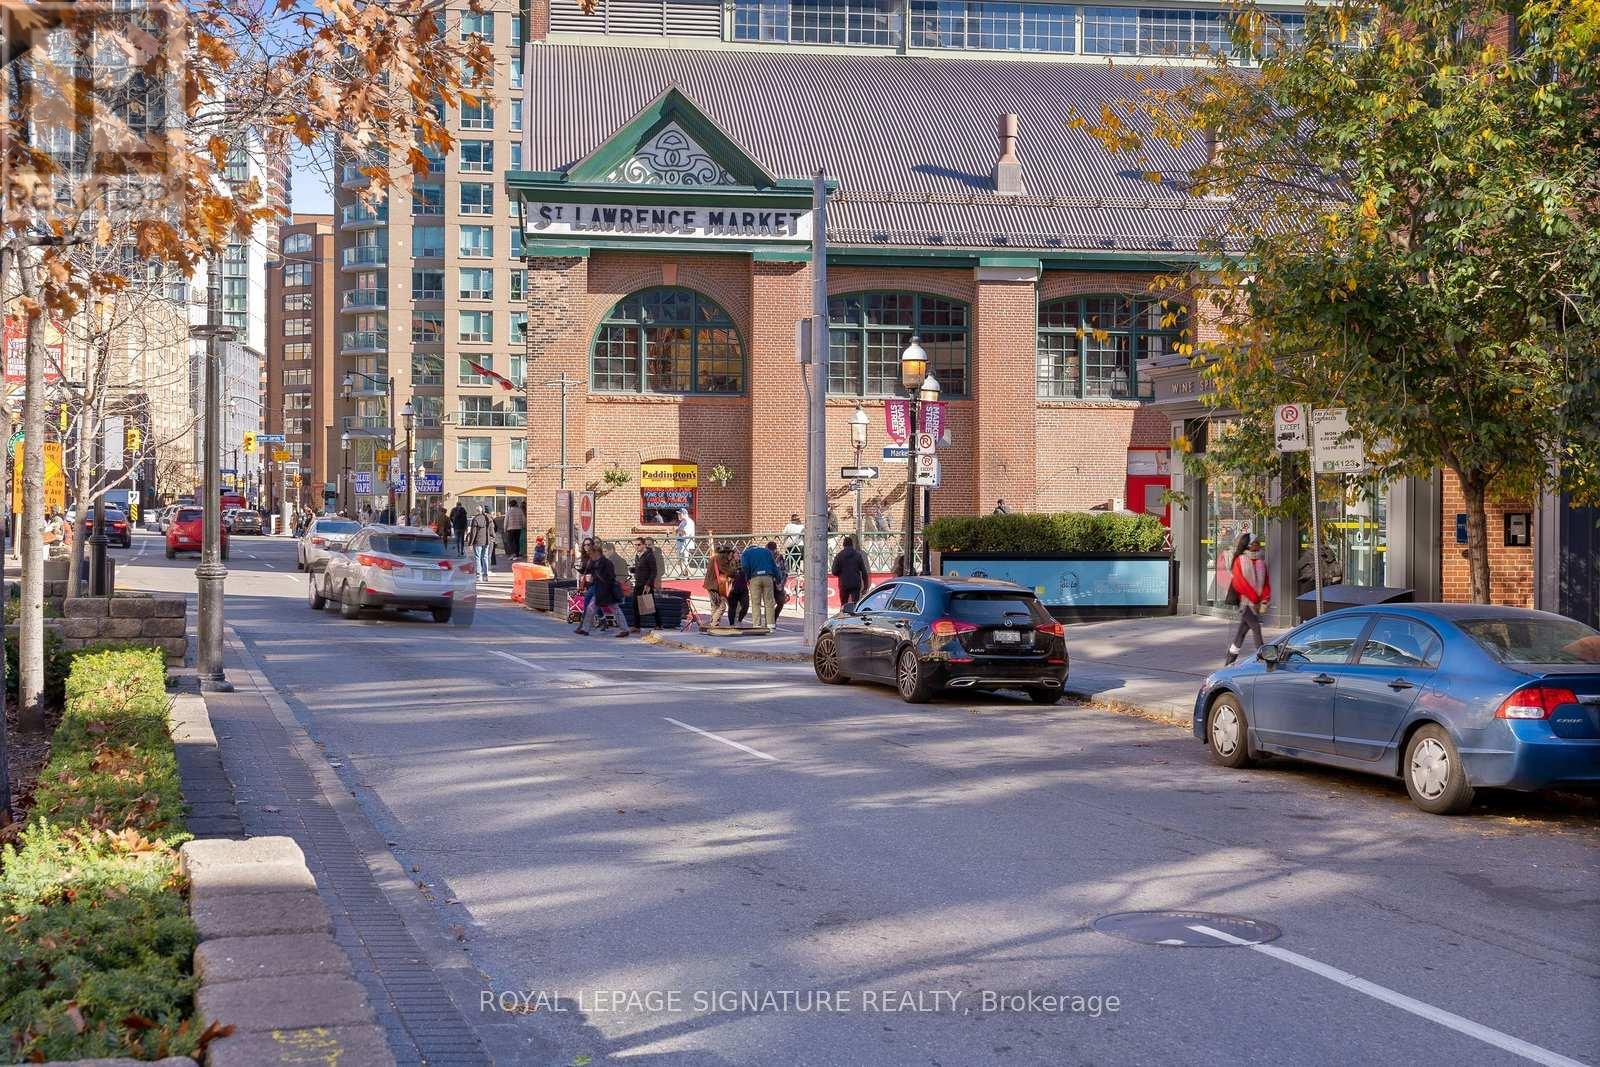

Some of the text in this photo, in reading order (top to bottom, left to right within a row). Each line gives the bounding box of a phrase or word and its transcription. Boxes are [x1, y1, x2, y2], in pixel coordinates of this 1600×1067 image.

[576, 207, 696, 228] LAWRENCE
[708, 210, 801, 230] MARKET
[1170, 382, 1194, 393] WINE
[890, 404, 898, 434] STREET
[898, 404, 906, 438] MARKET
[1280, 423, 1300, 431] EXCEPT
[890, 449, 909, 457] Marke
[642, 470, 697, 481] Paddington's
[356, 483, 370, 493] VAPE
